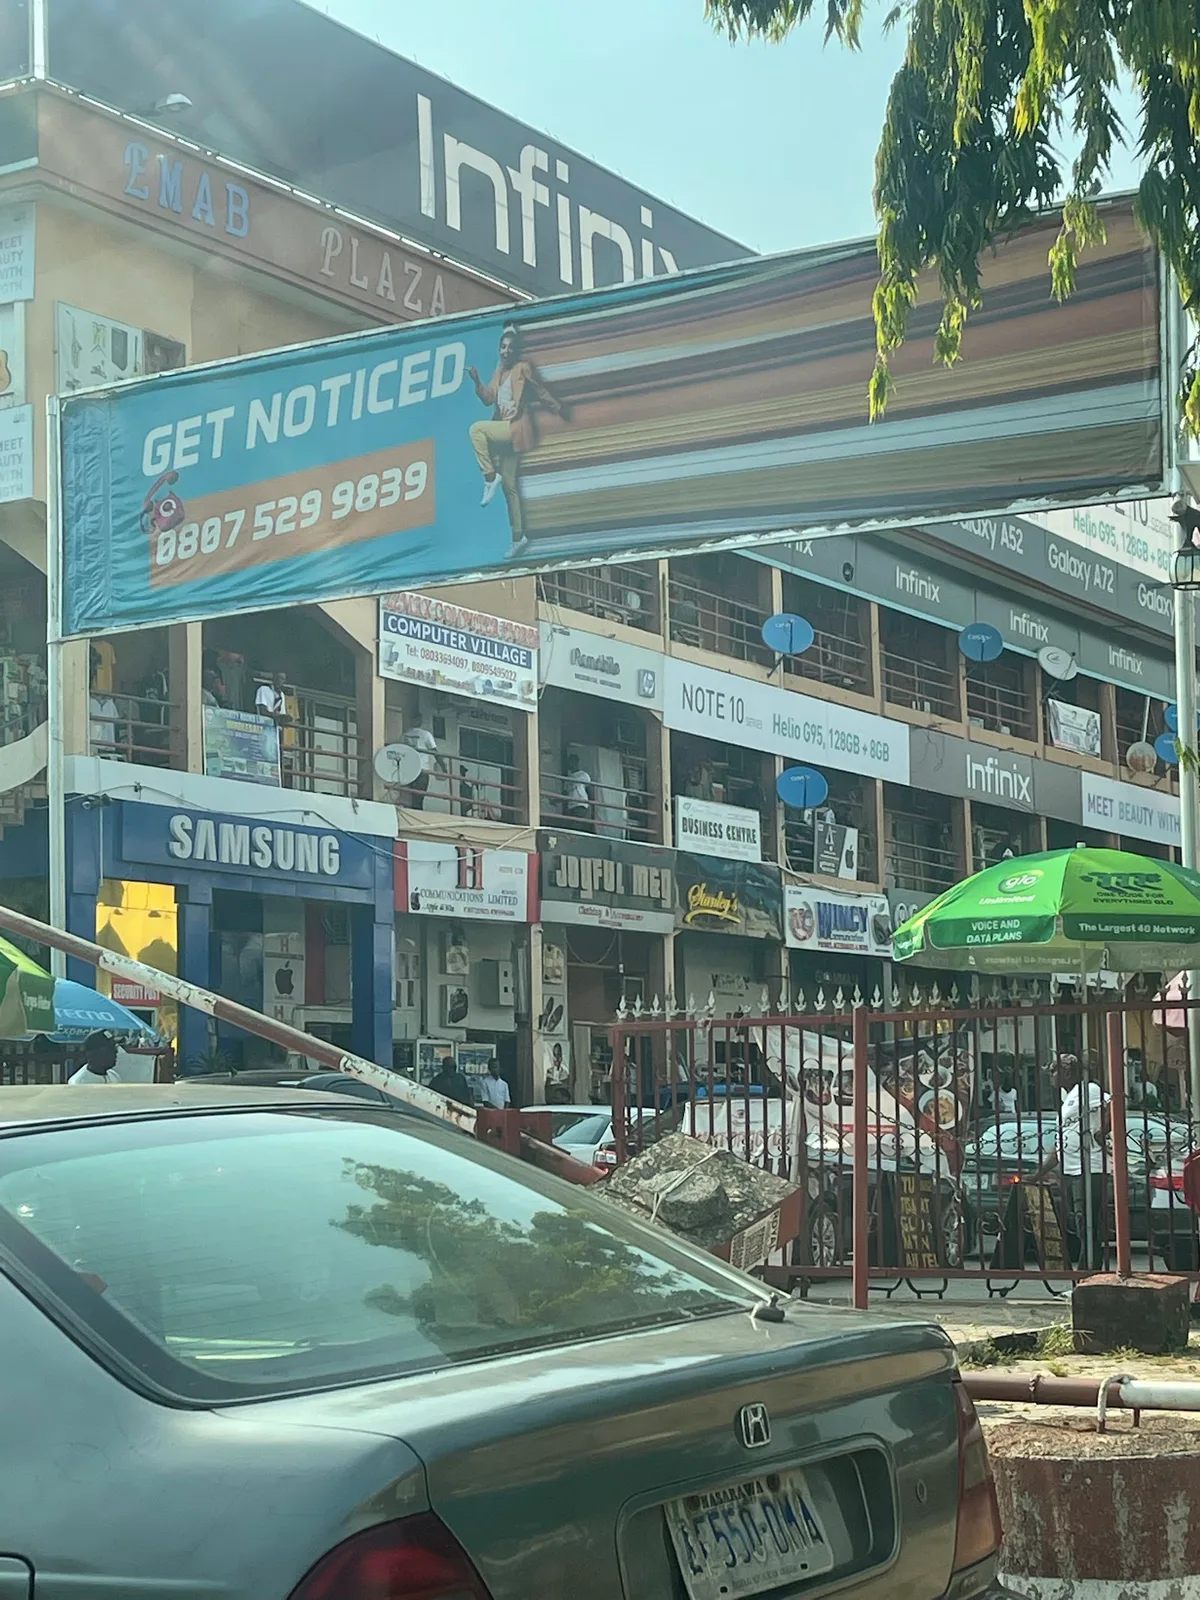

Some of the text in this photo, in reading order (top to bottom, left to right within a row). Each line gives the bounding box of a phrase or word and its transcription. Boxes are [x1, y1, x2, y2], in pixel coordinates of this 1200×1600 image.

[123, 141, 447, 317] EMAB PLAZA
[143, 341, 467, 477] GET NOTICED
[156, 461, 428, 567] 0807 529 9839
[952, 517, 1024, 555] alaxy A52
[1073, 510, 1098, 538] Helio
[1098, 521, 1119, 552] G95,
[1121, 531, 1149, 562] 128GB
[896, 565, 940, 604] Infinix
[1048, 543, 1115, 594] Galaxy A72
[388, 615, 468, 651] COMPUTER
[470, 638, 527, 666] VILLAGE
[1010, 609, 1049, 644] Infinix
[405, 643, 419, 657] Tel:
[1108, 645, 1143, 676] Infinix
[682, 683, 725, 720] NOTE
[730, 696, 744, 725] 10
[773, 713, 801, 740] Helio
[803, 722, 826, 750] G95,
[829, 729, 860, 755] 128GB
[870, 740, 890, 763] 8GB
[966, 754, 1031, 803] Infinix
[682, 817, 757, 844] BUSINESS CENTRE
[1087, 793, 1181, 834] MEET BEAUTY WITH
[169, 814, 340, 876] SAMSUNG
[455, 846, 484, 890] H
[1005, 874, 1037, 890] glo
[488, 893, 518, 906] LIMITED
[979, 895, 1036, 905] Unlimited
[966, 931, 1023, 944] DATA PLANS
[971, 919, 1021, 931] VOICE AND
[1079, 922, 1097, 932] The
[1098, 924, 1137, 935] Largest
[1153, 925, 1196, 935] Network
[113, 983, 160, 1001] SECURITY POST
[54, 1007, 115, 1022] TECNO
[700, 1480, 764, 1510] NASARAWA
